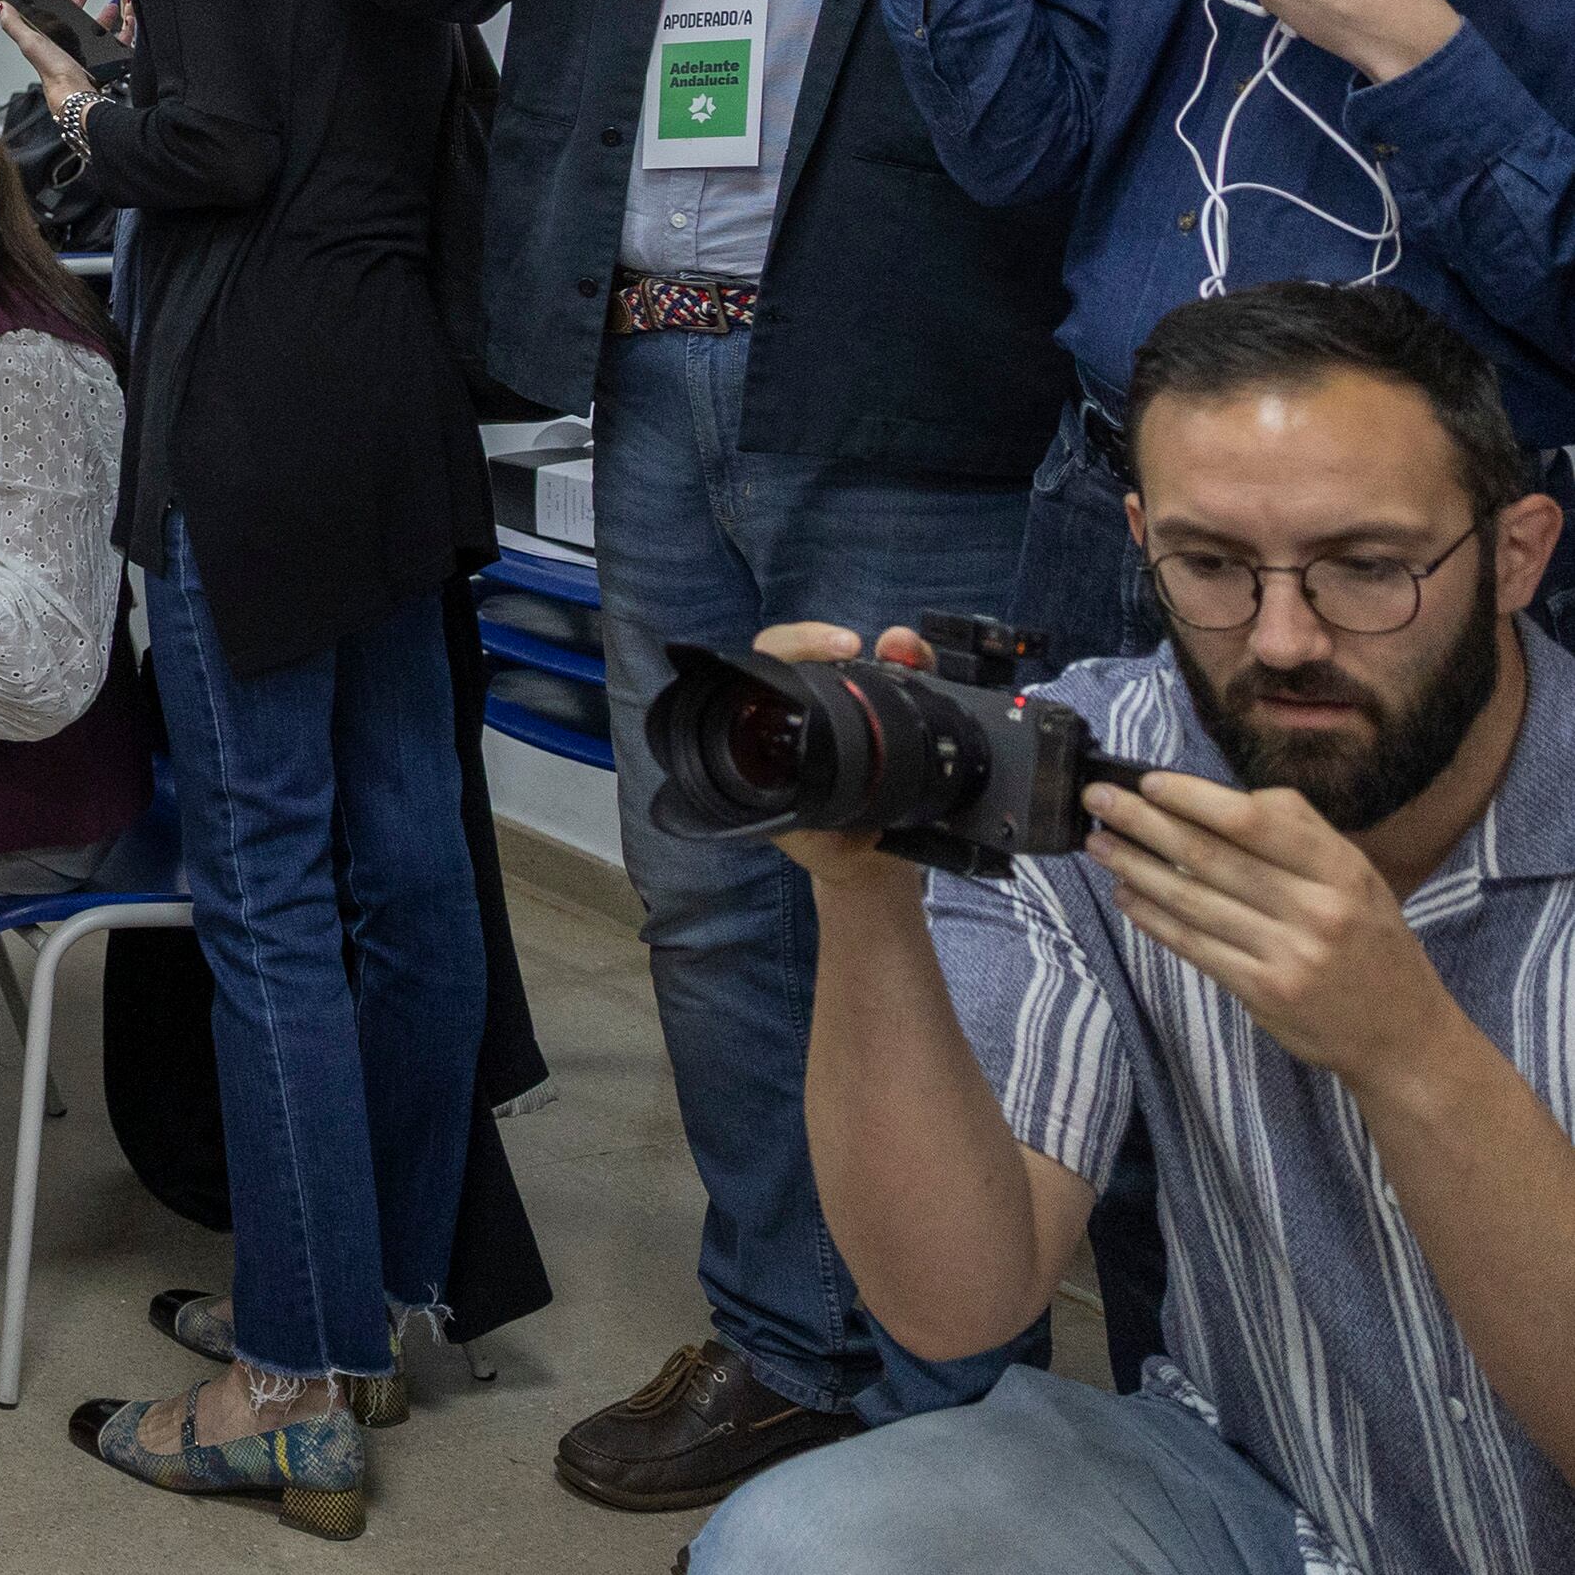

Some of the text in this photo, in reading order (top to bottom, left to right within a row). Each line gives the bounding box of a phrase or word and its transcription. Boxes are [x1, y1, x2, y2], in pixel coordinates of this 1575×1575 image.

[663, 9, 752, 30] APODERADO/A
[670, 60, 740, 75] Adelante
[670, 73, 739, 88] Andalucía
